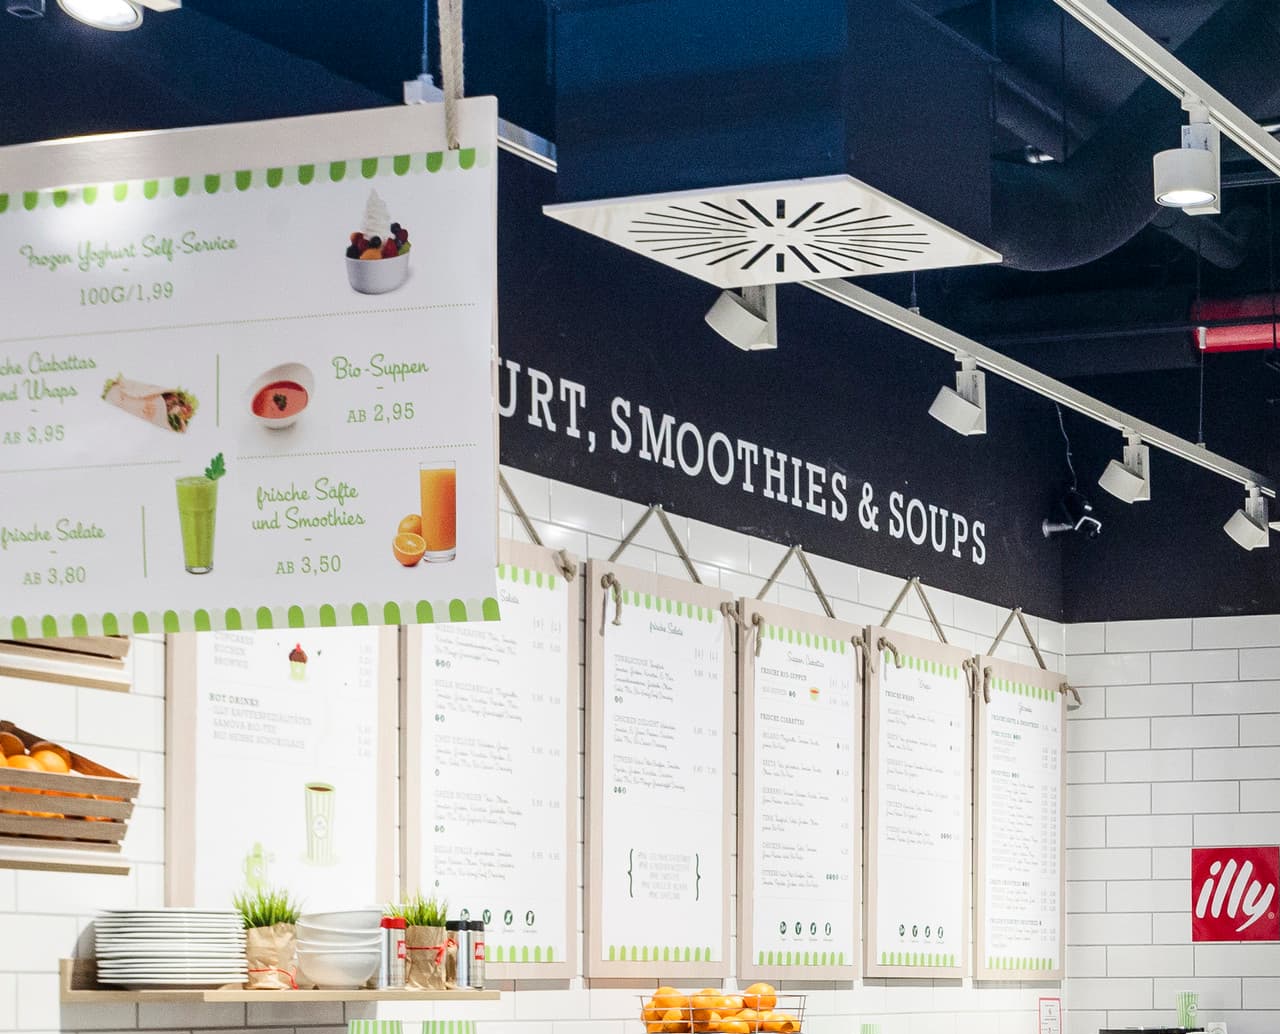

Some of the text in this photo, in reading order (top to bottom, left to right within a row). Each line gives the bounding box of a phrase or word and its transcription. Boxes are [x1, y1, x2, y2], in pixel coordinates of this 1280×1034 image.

[19, 231, 239, 272] Frozen Yoghurt Self-Service
[28, 351, 97, 375] Ciabattas
[331, 352, 430, 387] Bio-Suppen
[23, 378, 78, 405] Wraps
[346, 402, 415, 424] AB 2,95
[3, 424, 65, 445] AB 3,95
[611, 396, 849, 522] SMOOTHIES
[858, 481, 880, 532] &
[889, 490, 987, 566] SOUPS
[257, 481, 310, 510] frische
[252, 506, 366, 530] und Smoothies
[1, 518, 106, 550] frische Salate
[23, 566, 86, 586] AB 3,80
[276, 555, 341, 576] AB 3,50
[1195, 858, 1275, 932] illy
